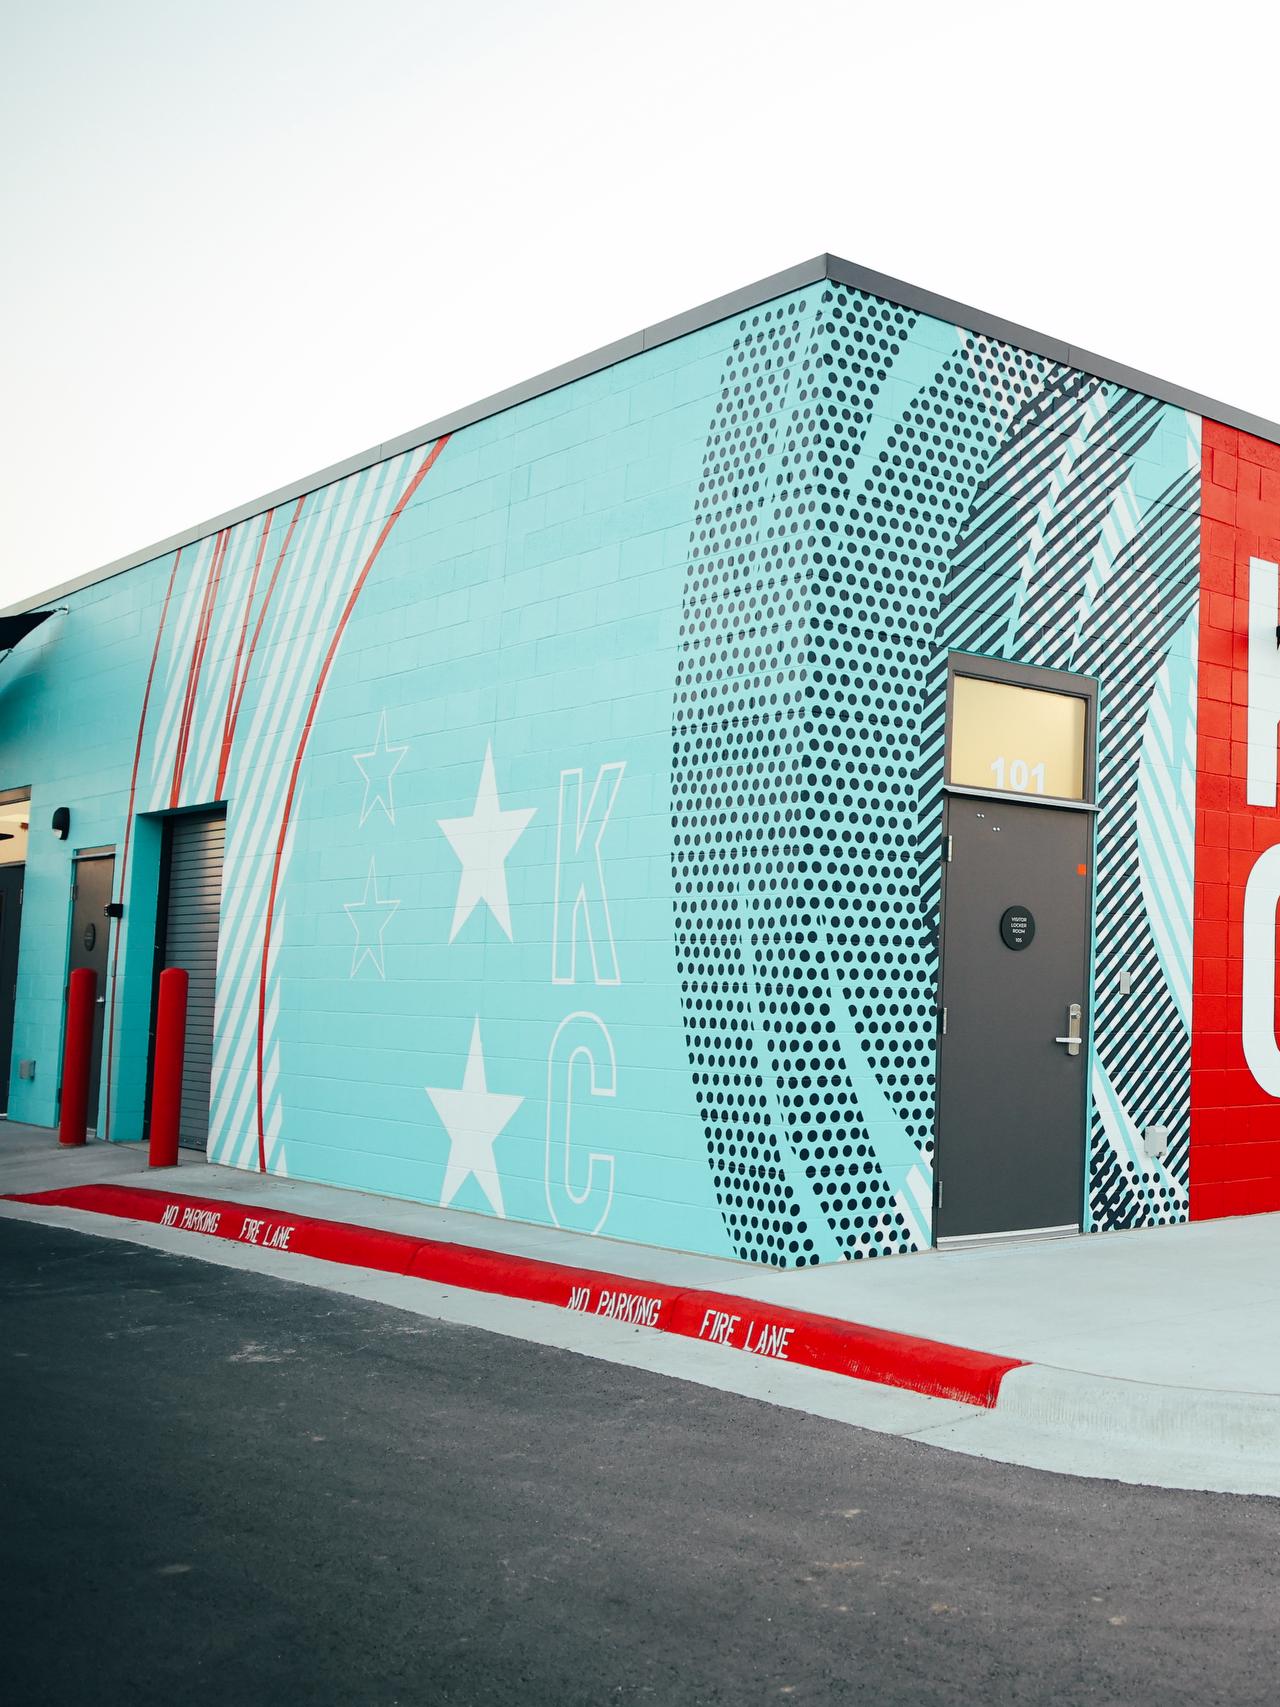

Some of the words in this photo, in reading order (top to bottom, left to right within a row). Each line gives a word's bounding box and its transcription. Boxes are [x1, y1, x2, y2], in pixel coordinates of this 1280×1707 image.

[991, 756, 1046, 794] 101
[545, 761, 627, 1235] KC
[160, 1204, 179, 1226] NO
[180, 1207, 221, 1233] PARKING
[238, 1217, 265, 1243] FIRE
[262, 1223, 296, 1249] LANE
[566, 1286, 591, 1313] NO
[594, 1290, 662, 1327] PARKING
[699, 1309, 741, 1347] FIRE
[742, 1320, 795, 1359] LANE
